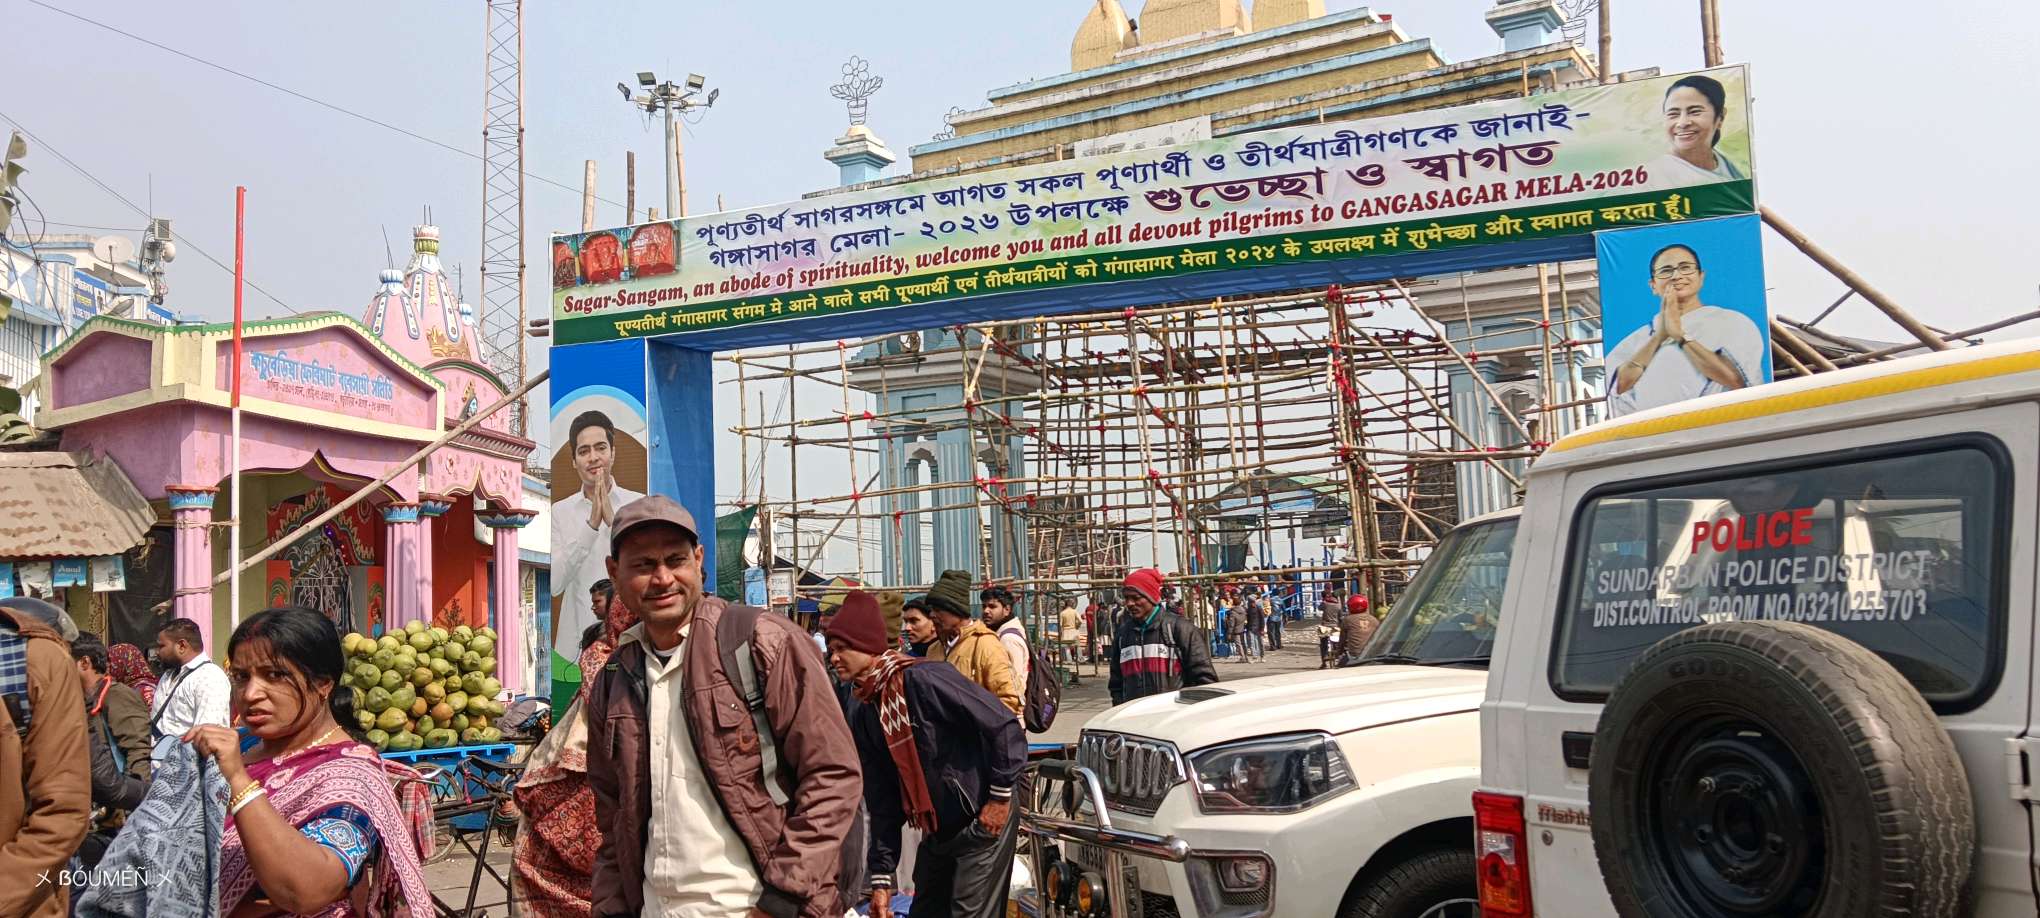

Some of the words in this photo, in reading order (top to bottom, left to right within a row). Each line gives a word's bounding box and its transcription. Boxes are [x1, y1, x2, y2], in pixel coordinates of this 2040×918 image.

[563, 285, 688, 313] Sagar-Sangam,
[693, 283, 715, 297] an
[719, 274, 771, 294] abode
[775, 268, 794, 289] of
[799, 255, 910, 286] spirituality,
[915, 240, 1001, 270] welcome
[1006, 241, 1044, 262] you
[1050, 228, 1089, 252] and
[1094, 225, 1122, 247] all
[1128, 219, 1203, 244] devout
[1208, 208, 1304, 238] pilgrims
[1311, 204, 1334, 223] to
[1341, 184, 1508, 219] GANGASAGAR
[1514, 165, 1649, 199] MELA-2026
[696, 208, 790, 247] পূণ্যতীর্থ
[793, 195, 925, 228] সাগরসঙ্গমে
[933, 183, 1008, 208] আগত
[1017, 172, 1084, 196] সকল
[1202, 154, 1226, 171] ও
[1235, 123, 1459, 167] তীর্থযাত্রীগণকে
[709, 238, 816, 268] গঙ্গাসাগর
[830, 224, 905, 252] মেলা-
[920, 212, 1000, 240] ২০২৬
[1007, 196, 1131, 227] উপলক্ষে
[1144, 166, 1328, 212] শুভেচ্ছা
[1345, 163, 1386, 187] ও
[1403, 140, 1561, 183] স্বাগত
[671, 309, 728, 327] गंगासागर
[732, 303, 765, 320] संगम
[788, 293, 817, 312] आने
[822, 289, 853, 308] वाले
[859, 285, 890, 303] सभी
[953, 272, 978, 292] एवं
[1074, 258, 1097, 278] को
[1104, 254, 1175, 275] गंगासागर
[1180, 249, 1217, 267] मेला
[1225, 245, 1277, 263] २०२४
[1282, 238, 1301, 257] के
[1309, 234, 1375, 255] उपलक्ष्य
[1381, 226, 1400, 247] में
[1405, 223, 1476, 249] शुभेच्छा
[1484, 215, 1523, 236] और
[1529, 210, 1595, 231] स्वागत
[1600, 202, 1656, 221] करता
[1597, 565, 1720, 595] SUNDARBAN
[1724, 557, 1808, 587] POLICE
[1812, 550, 1932, 583] DISTRICT
[1692, 508, 1813, 553] POLICE
[1593, 598, 1701, 627] DIST.CONTROL
[1707, 593, 1759, 622] ROOM
